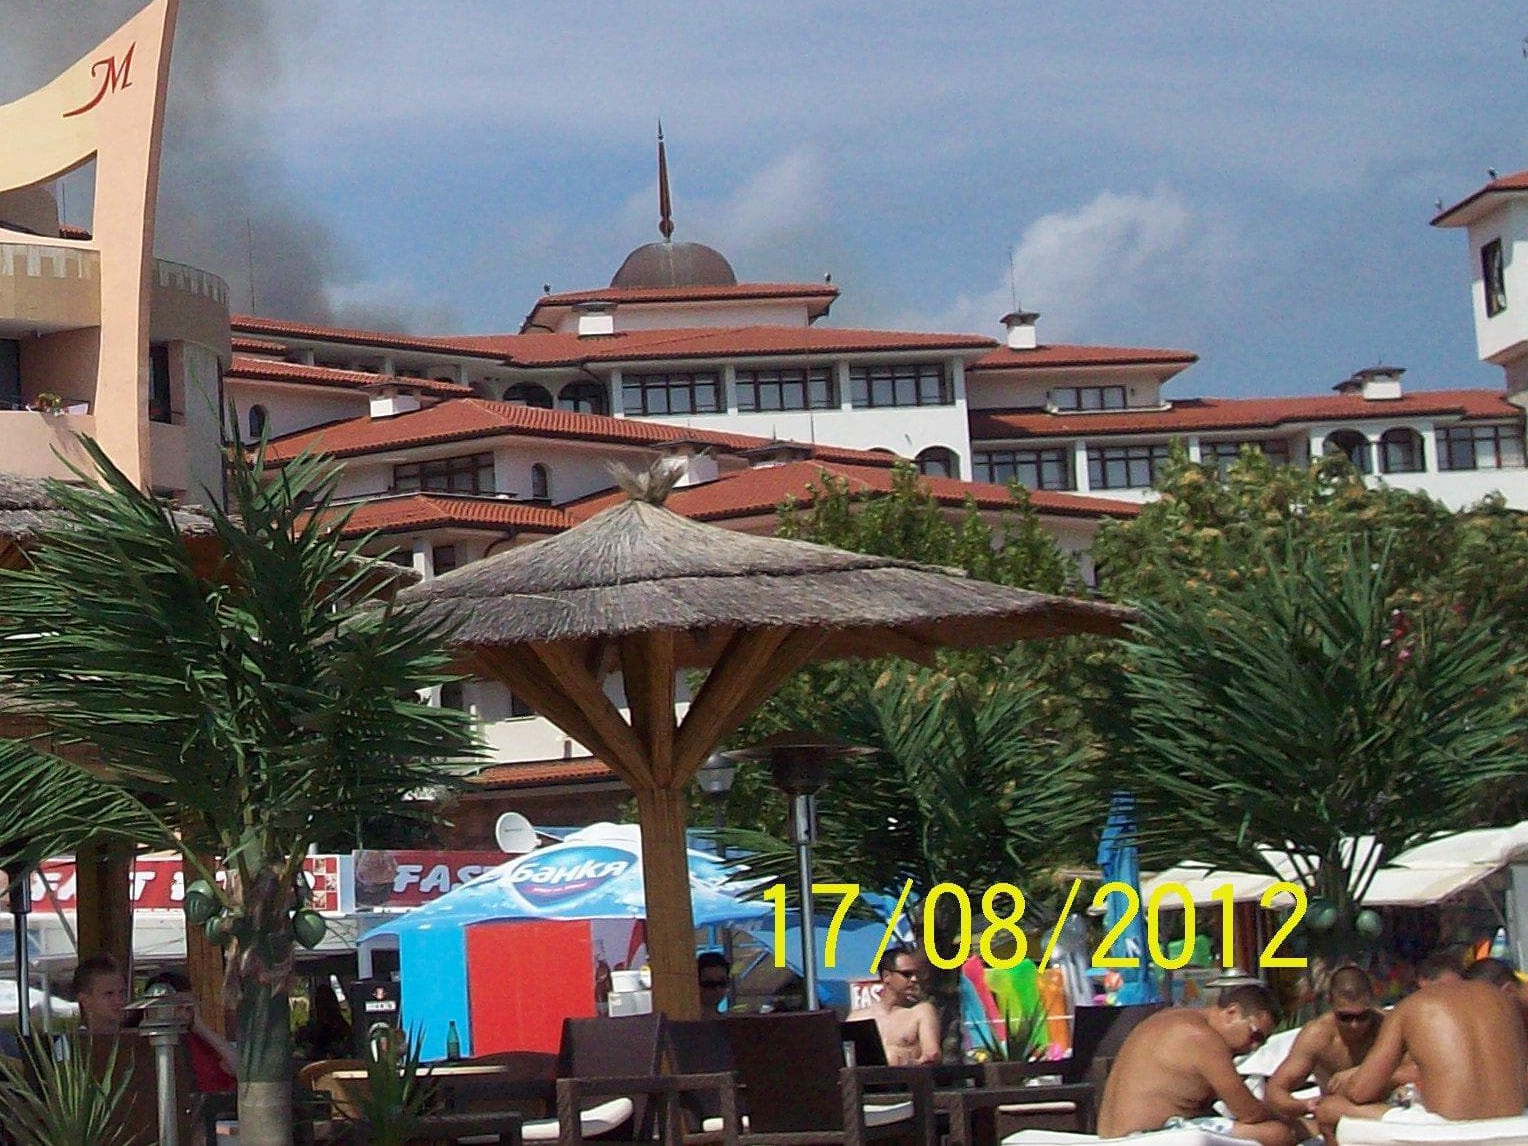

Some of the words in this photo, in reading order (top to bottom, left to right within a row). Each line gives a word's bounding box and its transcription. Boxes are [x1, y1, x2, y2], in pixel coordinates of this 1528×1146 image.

[62, 41, 136, 118] M
[392, 864, 500, 894] FAS
[852, 983, 885, 1011] FAS
